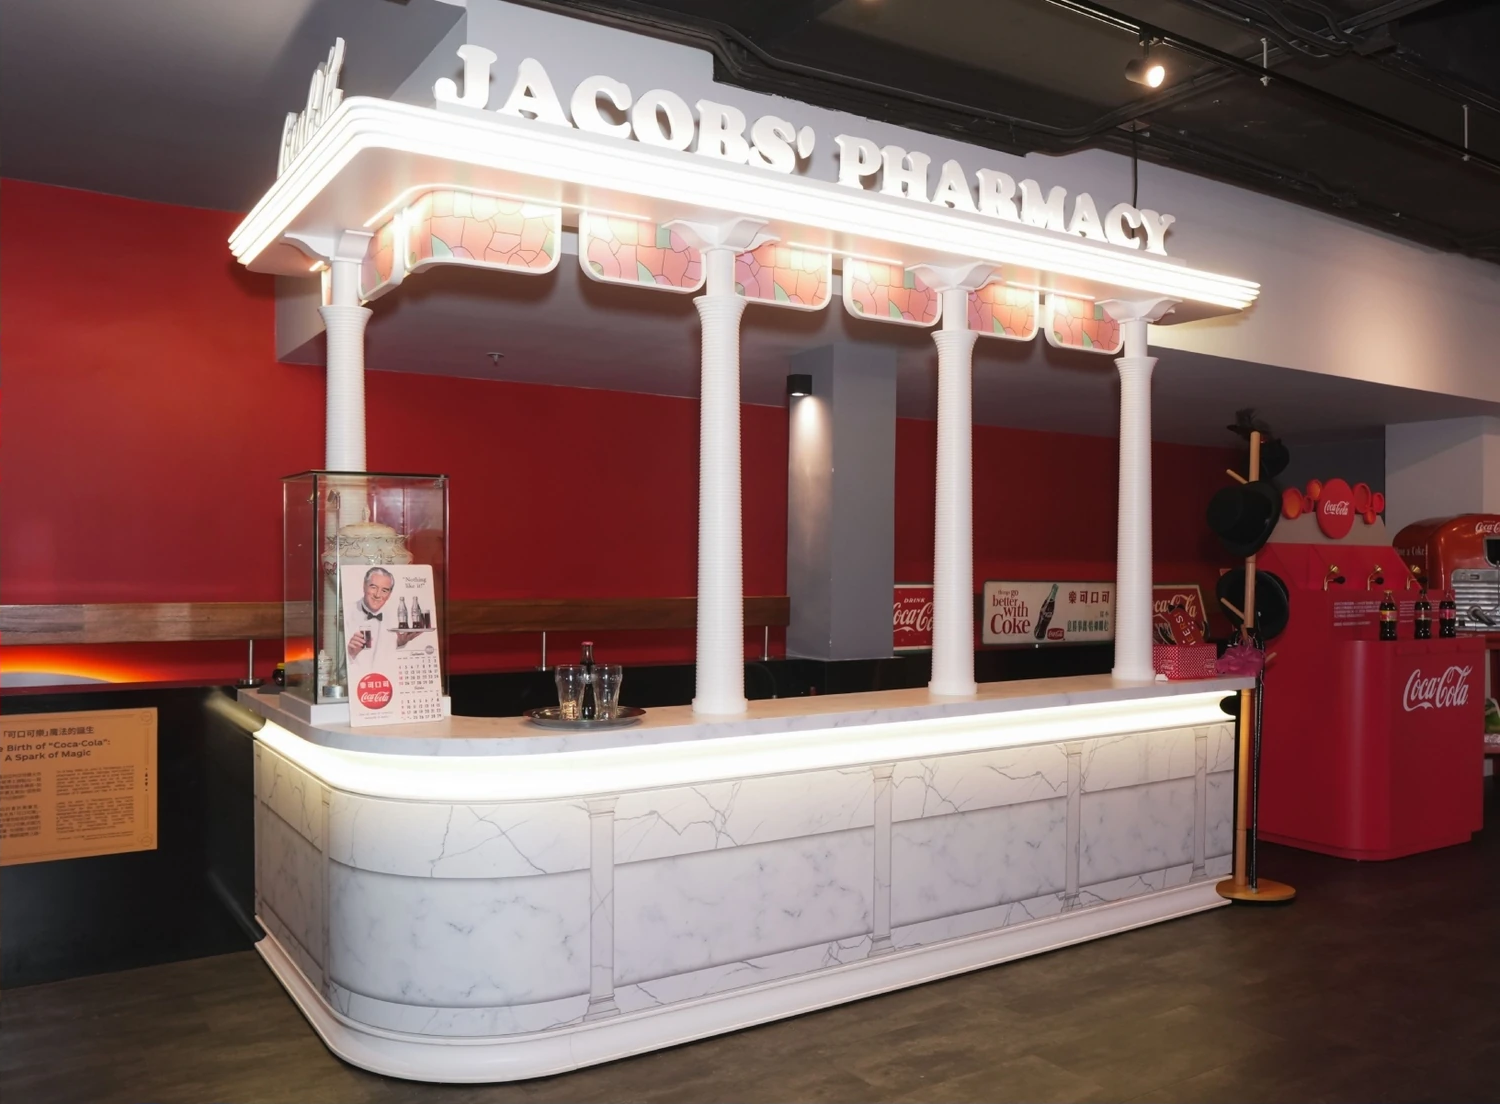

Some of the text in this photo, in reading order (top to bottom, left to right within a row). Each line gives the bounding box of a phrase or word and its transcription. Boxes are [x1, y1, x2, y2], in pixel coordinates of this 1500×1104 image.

[835, 134, 1177, 257] PHARMACY
[1323, 500, 1350, 516] Coca-Cola
[992, 594, 1018, 607] better
[1011, 589, 1019, 598] go
[1003, 601, 1029, 617] with
[990, 613, 1031, 635] Coke
[1403, 665, 1473, 712] Coca-Cola
[7, 741, 46, 752] Birth of
[15, 752, 46, 762] Spark
[48, 751, 59, 759] of
[61, 749, 92, 759] Magic
